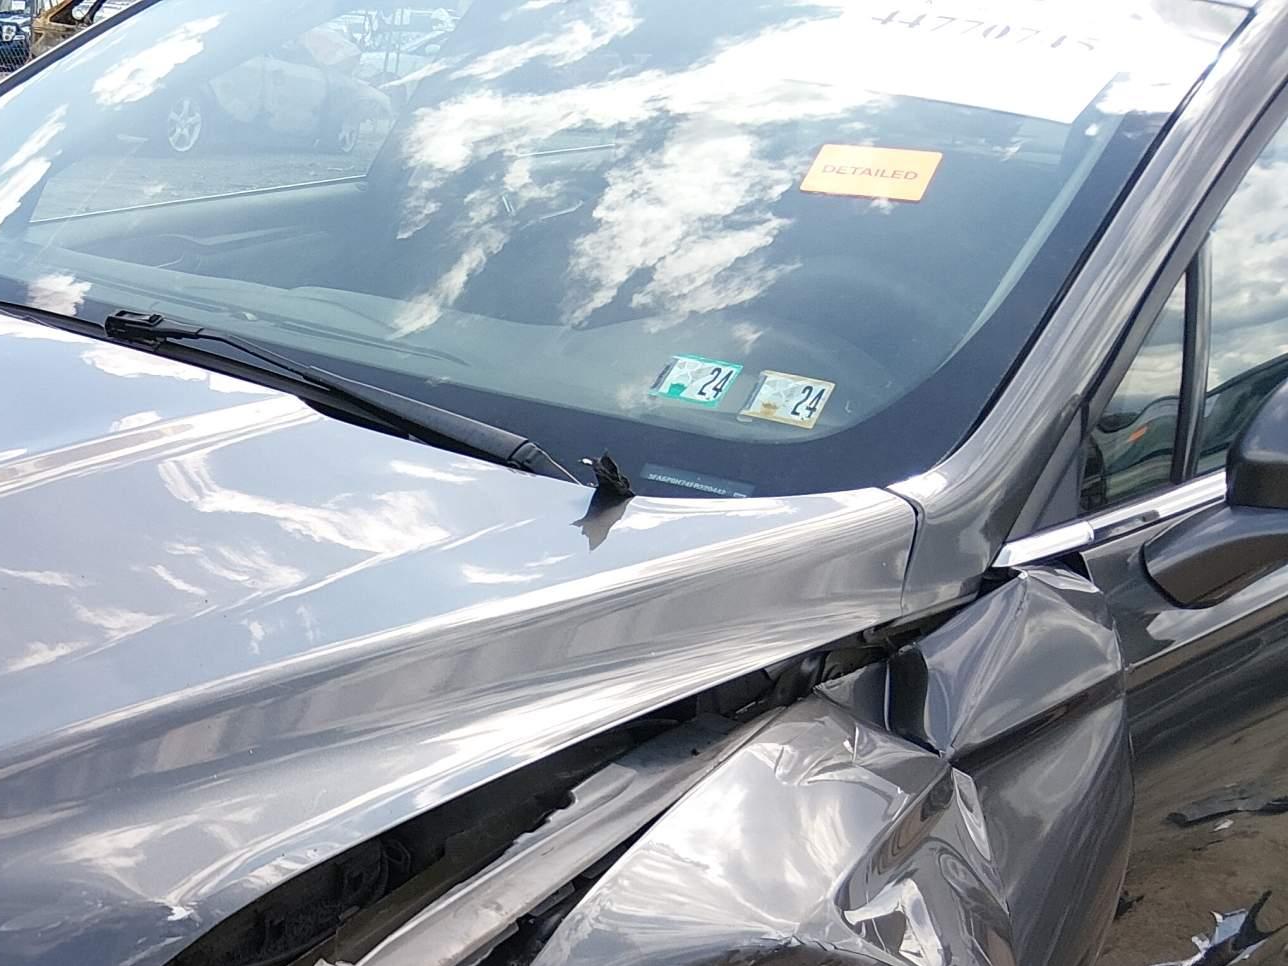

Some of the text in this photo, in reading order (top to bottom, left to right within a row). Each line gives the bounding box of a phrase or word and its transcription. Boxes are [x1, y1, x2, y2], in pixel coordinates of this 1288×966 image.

[821, 164, 919, 181] DETAILED
[697, 367, 734, 399] 24
[790, 385, 826, 419] 24
